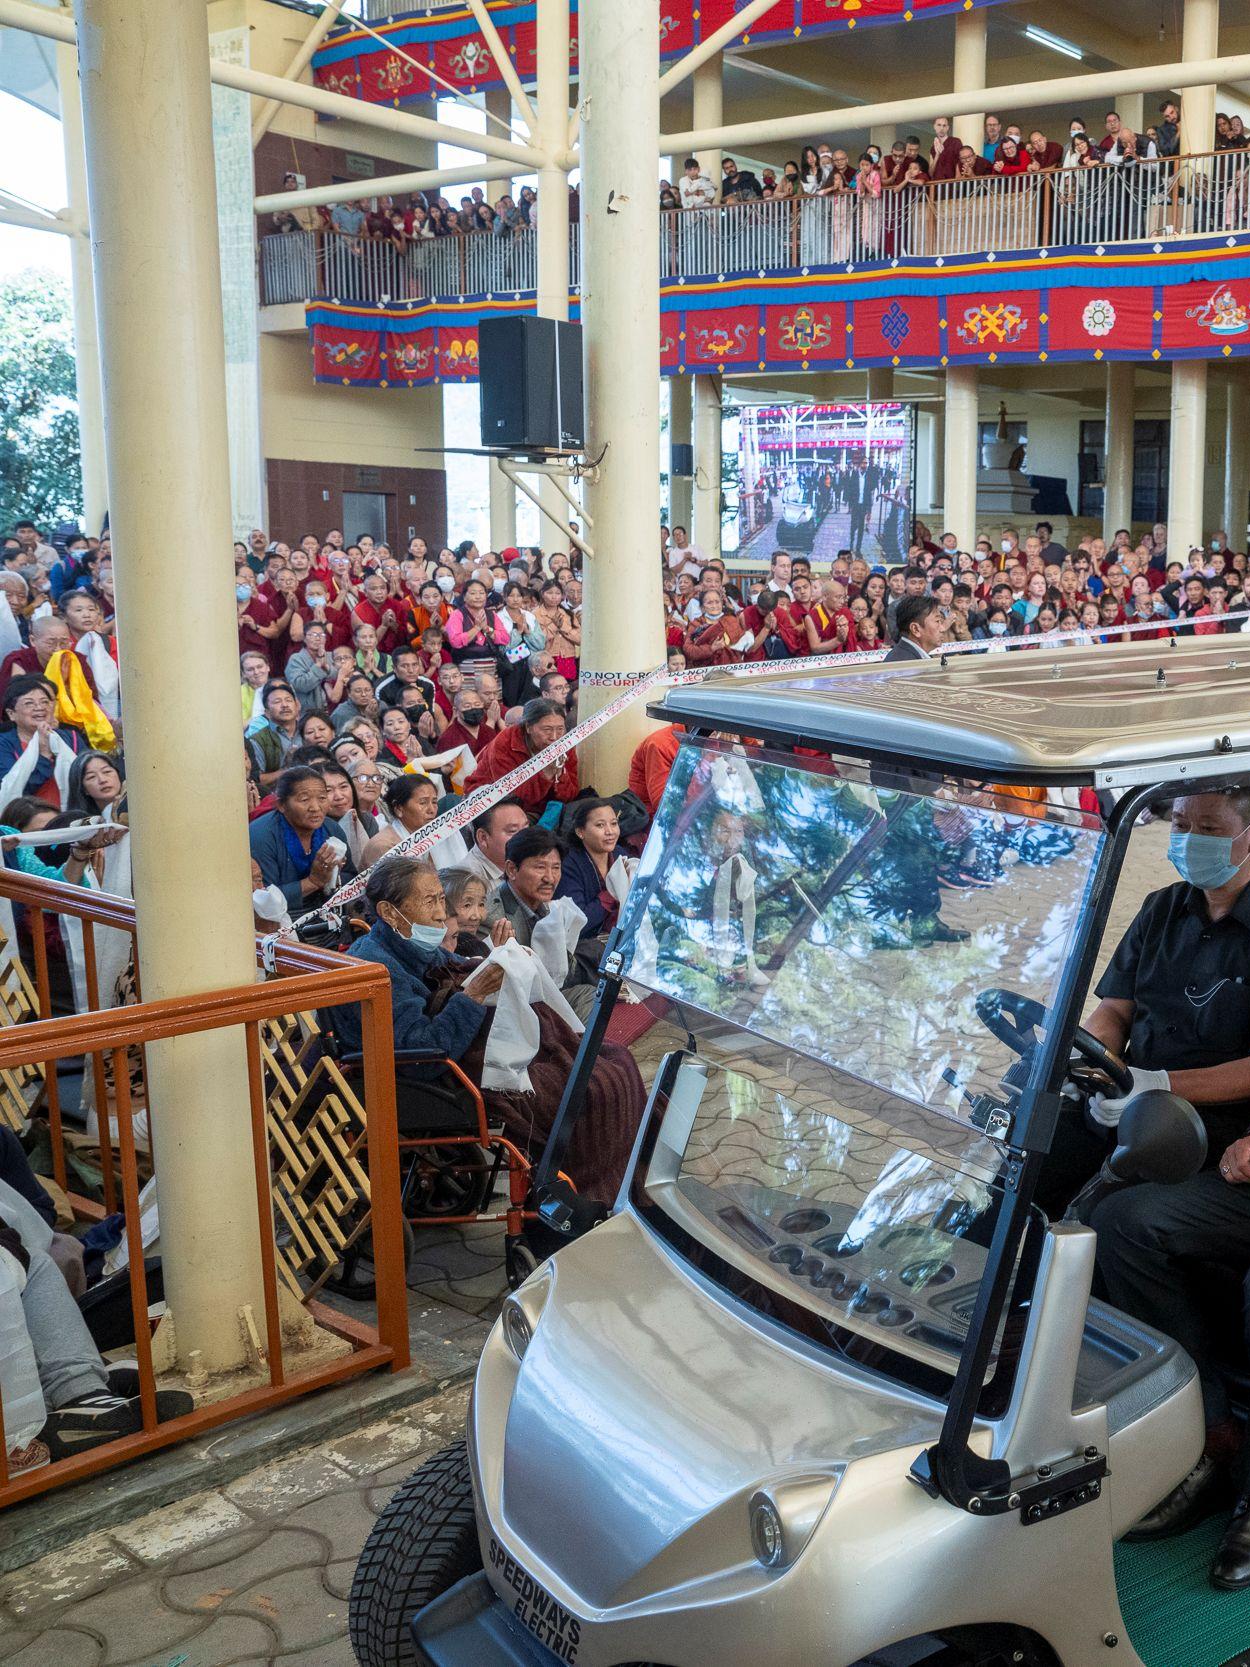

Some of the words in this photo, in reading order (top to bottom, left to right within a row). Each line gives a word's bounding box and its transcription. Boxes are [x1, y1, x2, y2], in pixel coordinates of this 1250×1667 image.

[761, 660, 781, 668] NOT
[590, 679, 640, 687] SECURI
[595, 672, 622, 680] NOT
[453, 800, 487, 826] SECURITY
[488, 1538, 582, 1645] SPEEDWAYS
[513, 1597, 578, 1665] ELECTRIC
